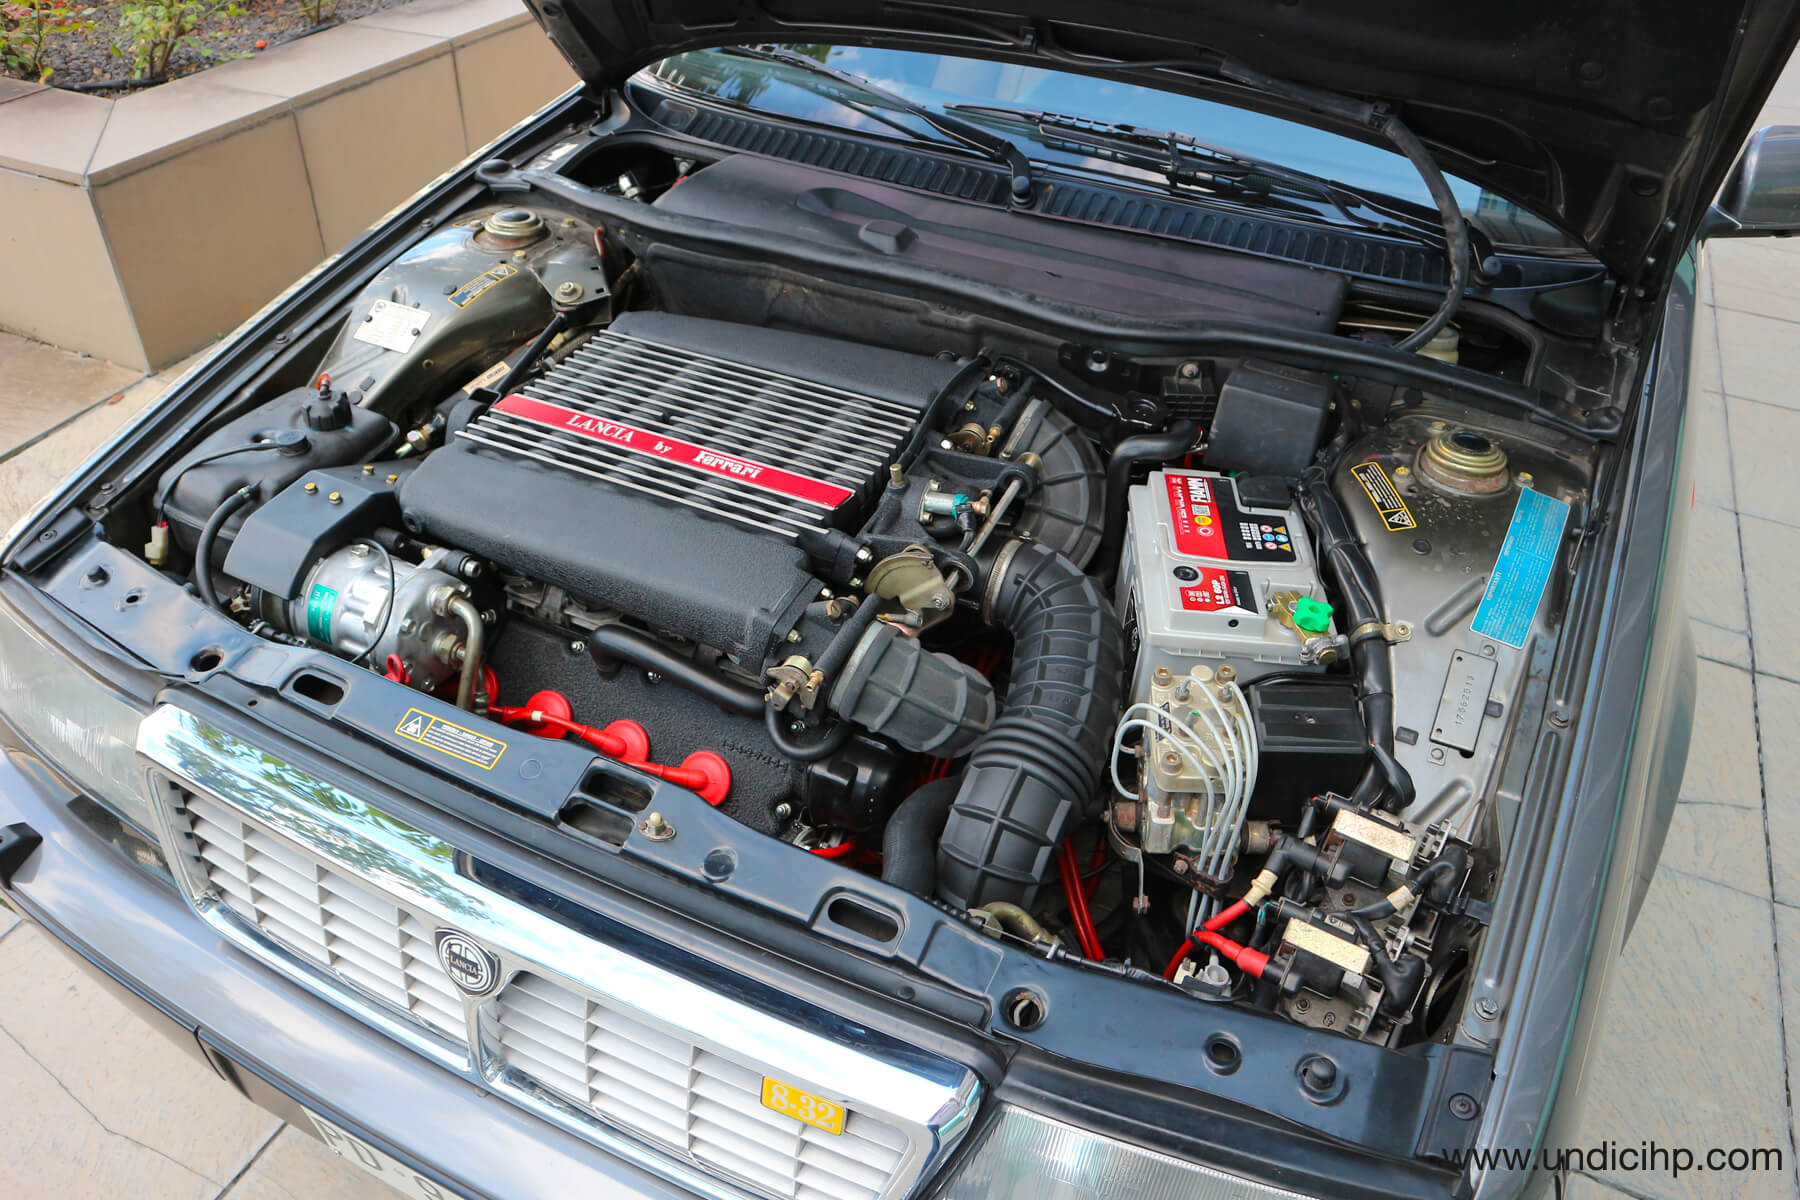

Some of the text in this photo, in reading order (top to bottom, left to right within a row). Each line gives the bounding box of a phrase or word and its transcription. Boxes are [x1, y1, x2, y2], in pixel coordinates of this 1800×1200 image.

[566, 414, 762, 479] LANCIA by Ferrari
[1187, 477, 1208, 503] FIAMM
[450, 954, 478, 976] LANCIA
